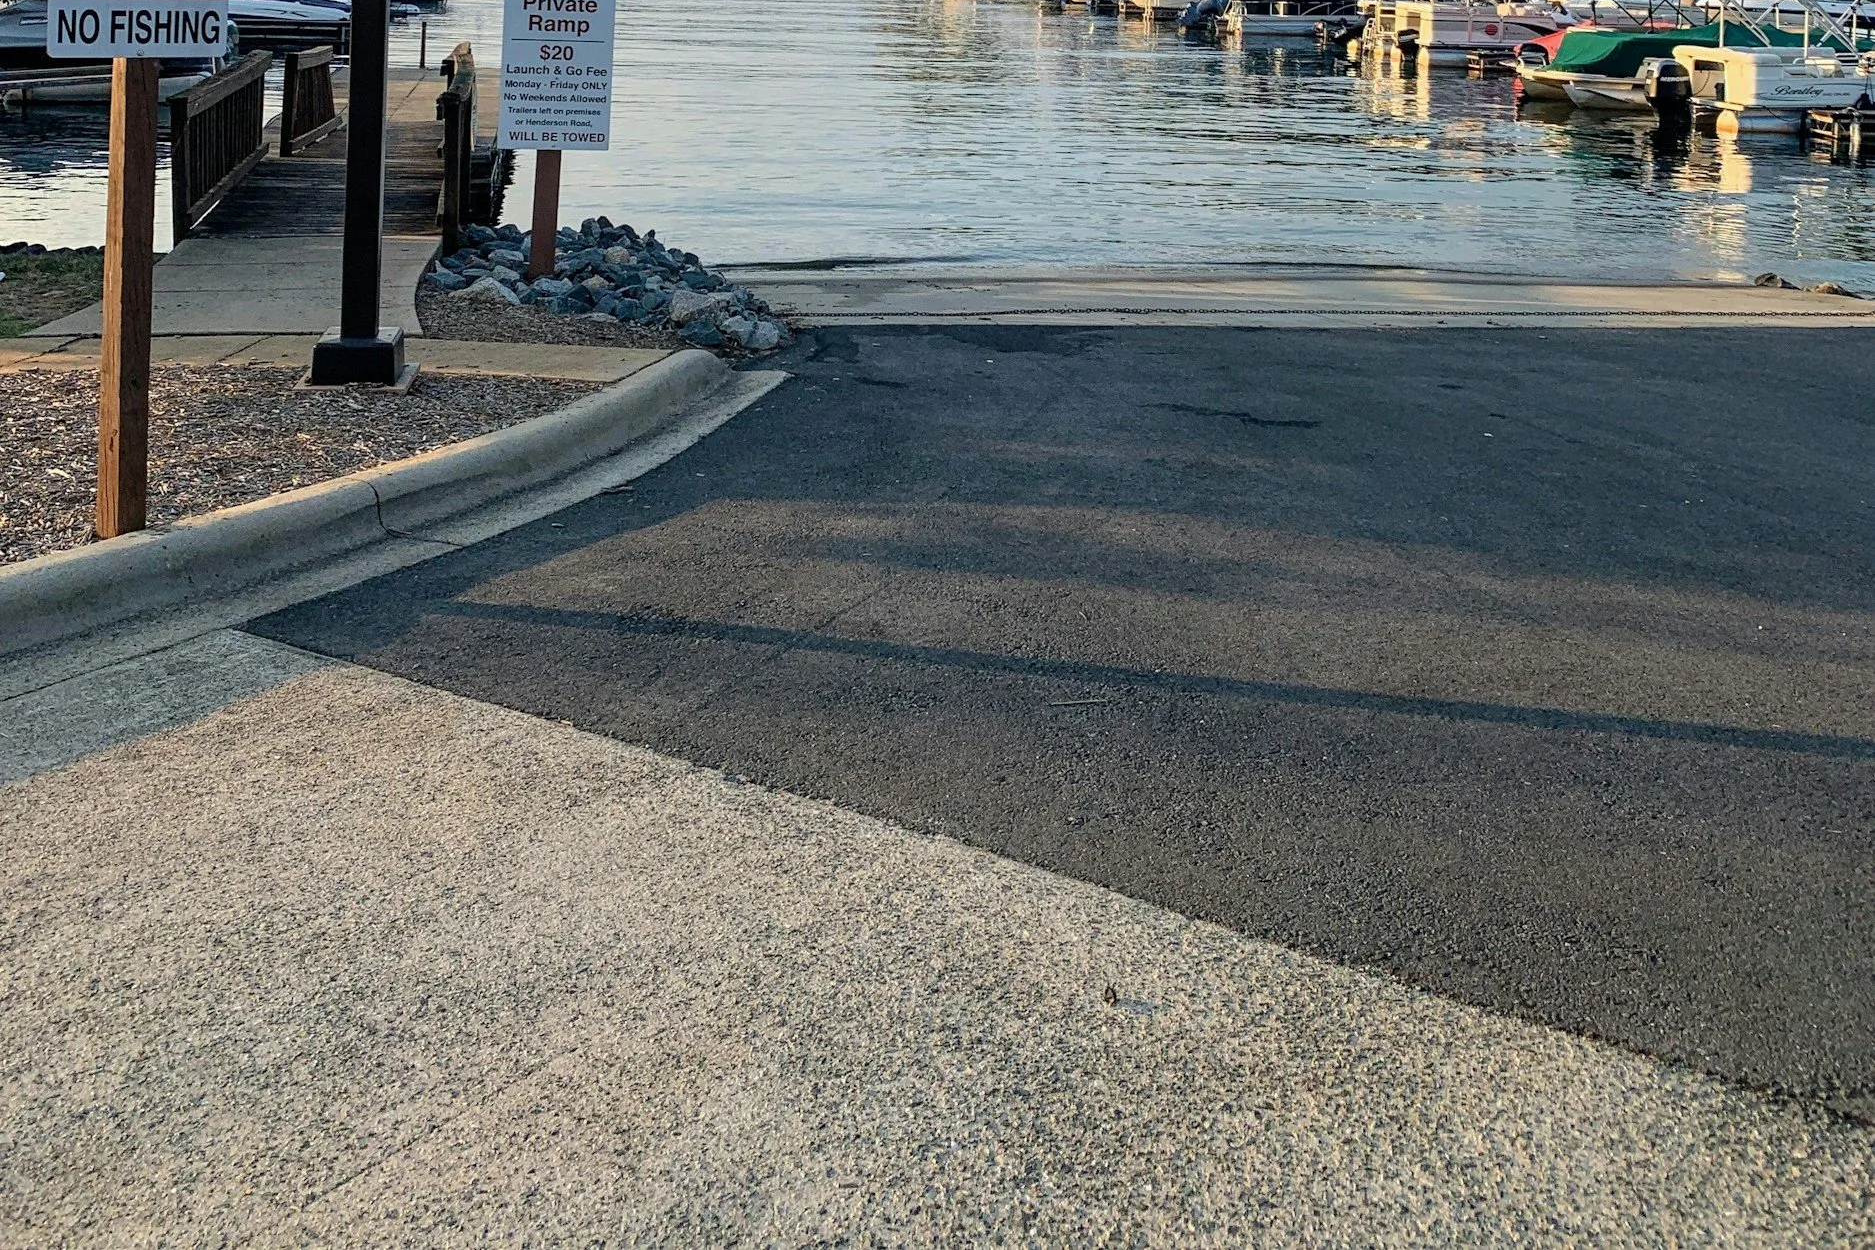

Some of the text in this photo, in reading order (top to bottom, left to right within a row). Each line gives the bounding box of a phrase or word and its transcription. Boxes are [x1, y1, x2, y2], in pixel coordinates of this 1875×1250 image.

[57, 9, 220, 44] NO FISHING
[528, 14, 590, 37] Ramp
[539, 44, 574, 61] $20
[506, 63, 608, 76] Launch & Go Fee
[505, 79, 542, 89] Monday
[549, 80, 579, 91] Friday
[581, 81, 608, 90] ONLY
[1770, 84, 1824, 98] Bentley
[503, 93, 607, 103] No Weekends Allowed
[508, 106, 537, 114] Trailers
[565, 108, 601, 116] premises
[508, 131, 605, 142] WILL BE TOWED
